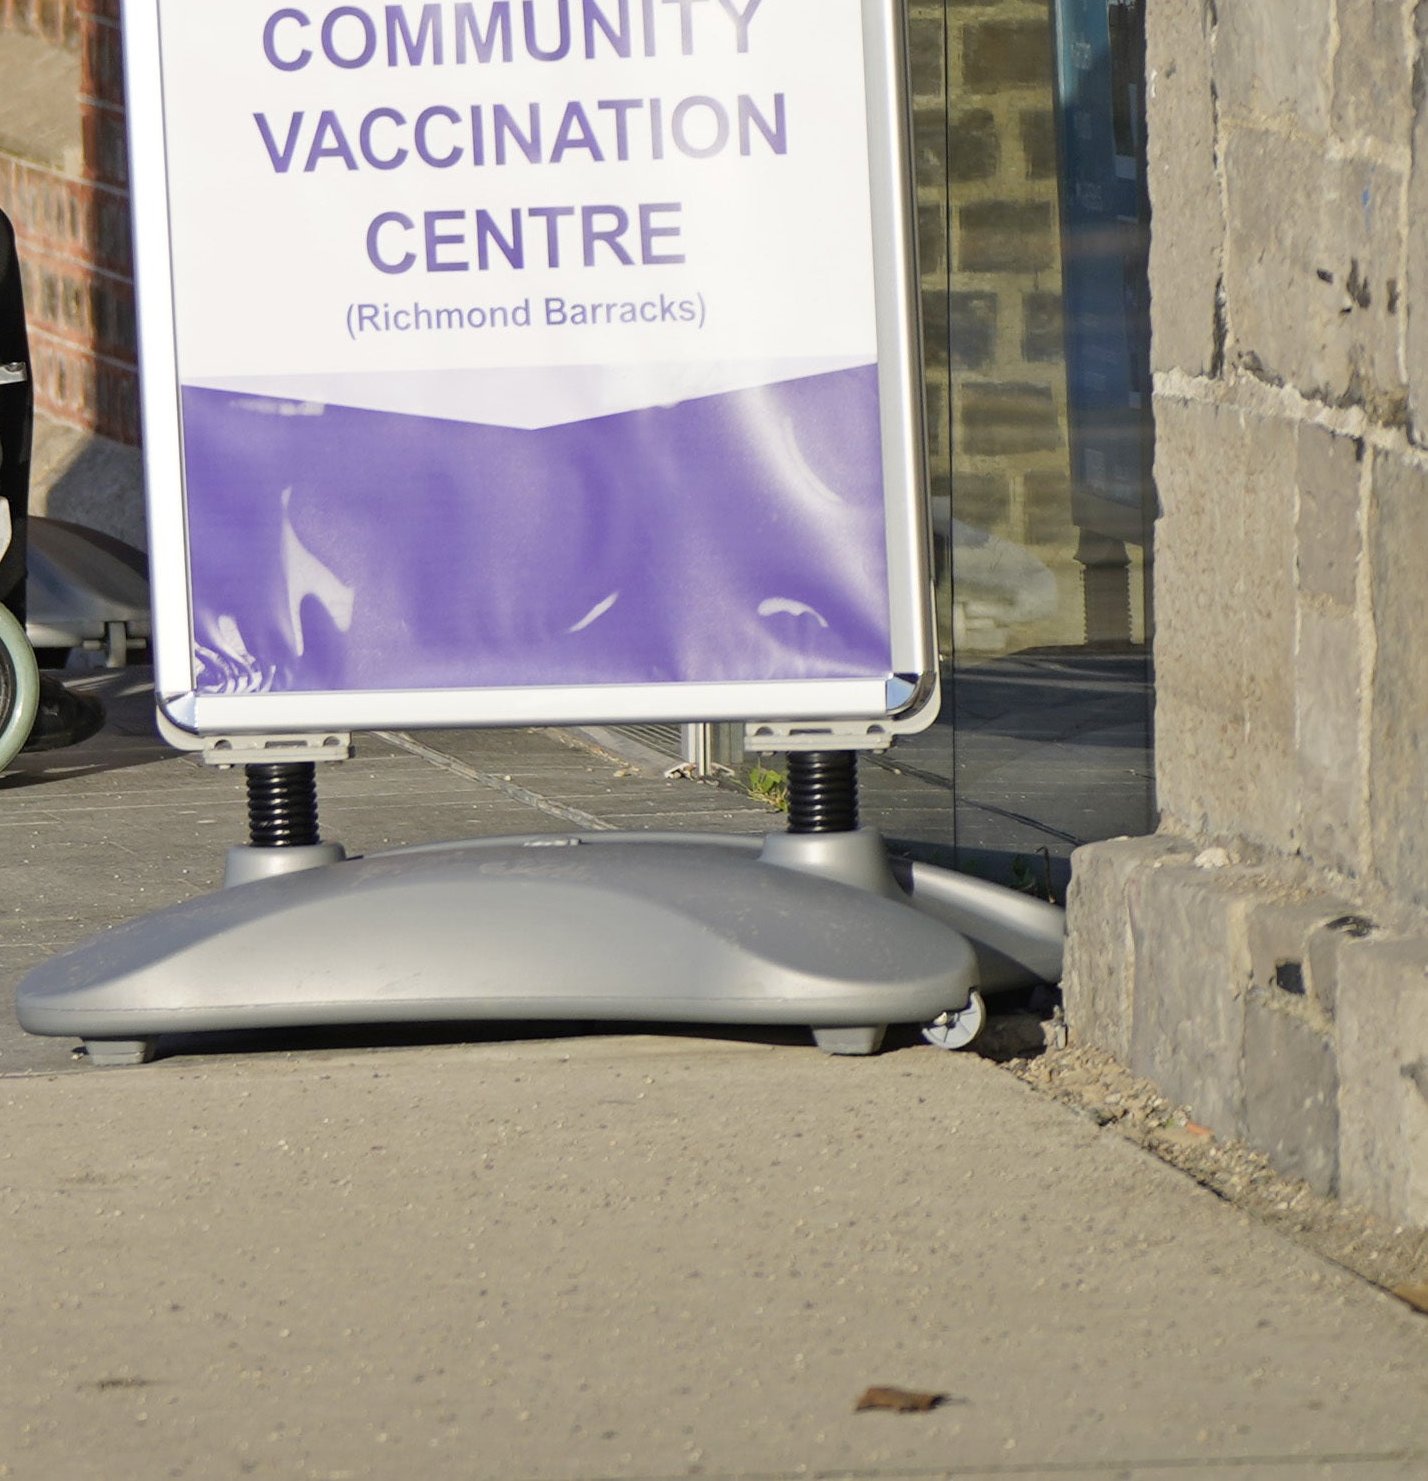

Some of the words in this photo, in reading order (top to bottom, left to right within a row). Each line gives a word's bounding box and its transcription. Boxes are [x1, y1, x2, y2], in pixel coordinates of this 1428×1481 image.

[251, 92, 788, 174] VACCINATION
[365, 201, 686, 276] CENTRE
[346, 297, 532, 341] (Richmond
[544, 292, 707, 329] Barracks)
